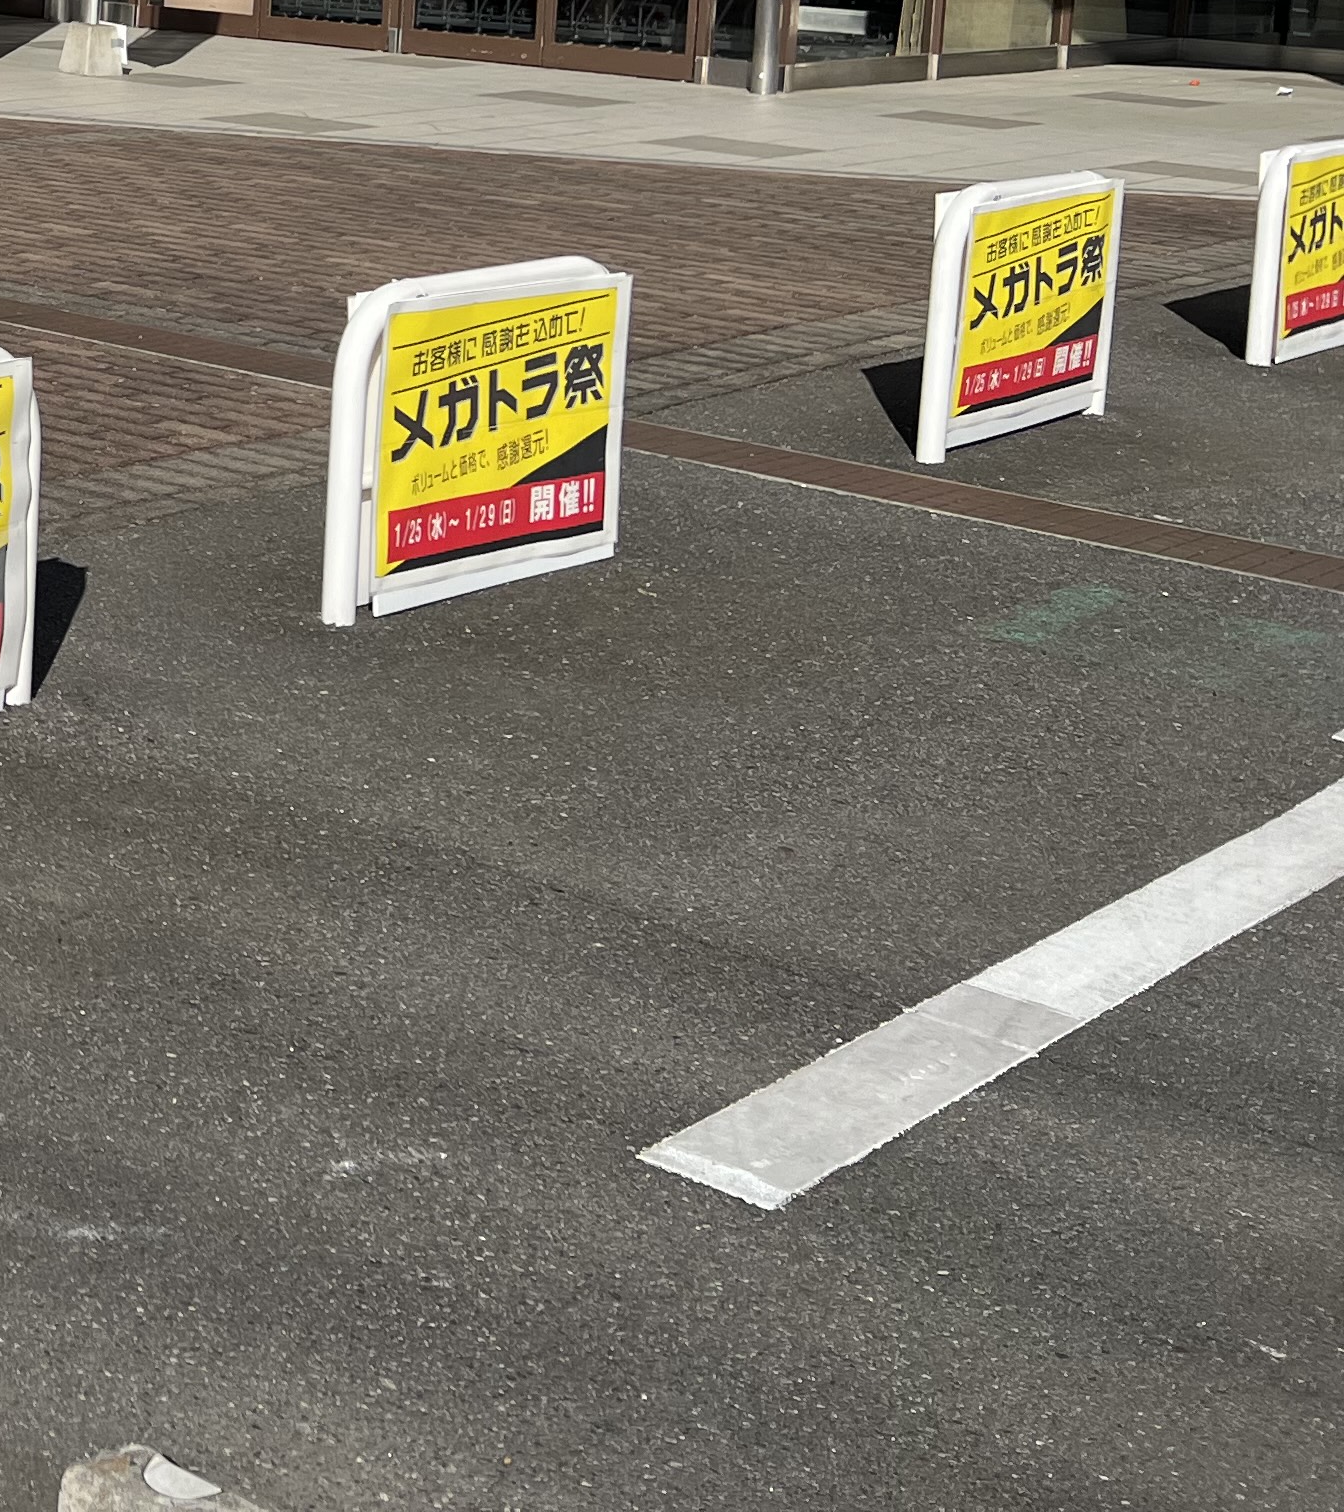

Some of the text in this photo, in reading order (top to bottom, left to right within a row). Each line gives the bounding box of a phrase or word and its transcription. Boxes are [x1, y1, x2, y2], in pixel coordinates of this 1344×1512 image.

[969, 235, 1105, 331] メガトラ祭
[412, 306, 586, 376] お客様に感謝を込めて!
[391, 344, 605, 463] メガトラ祭
[529, 478, 596, 524] 開催!!
